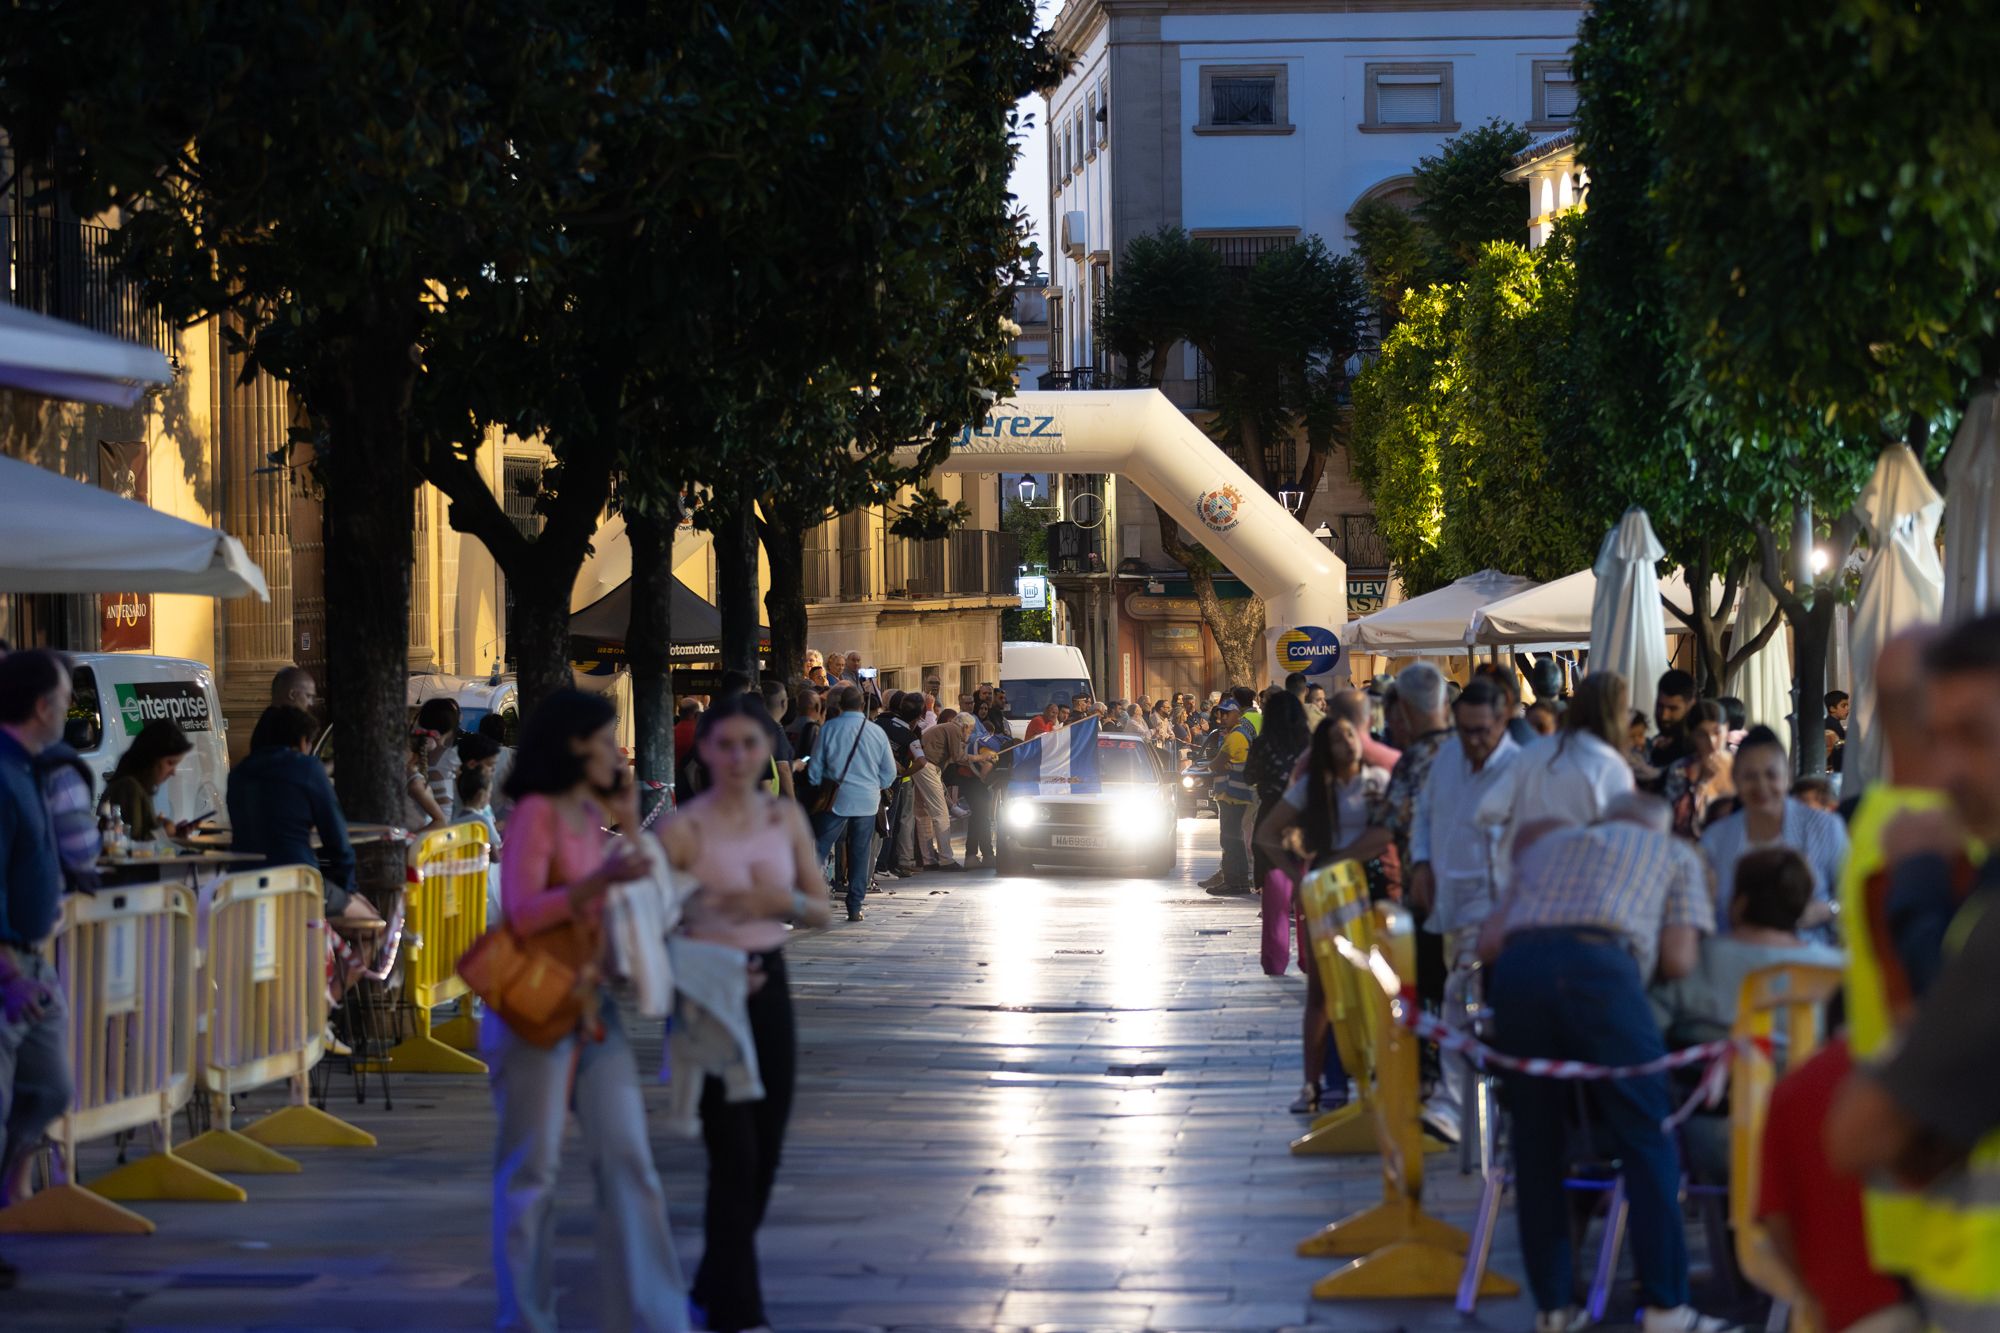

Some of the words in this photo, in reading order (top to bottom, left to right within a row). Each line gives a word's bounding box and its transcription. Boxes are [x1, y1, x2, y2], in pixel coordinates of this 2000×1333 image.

[1348, 582, 1386, 596] UEV
[106, 603, 147, 619] ANIVERSARIO
[1289, 645, 1337, 656] COMLINE
[120, 689, 208, 723] enterprise
[181, 718, 209, 730] rent-a-ca
